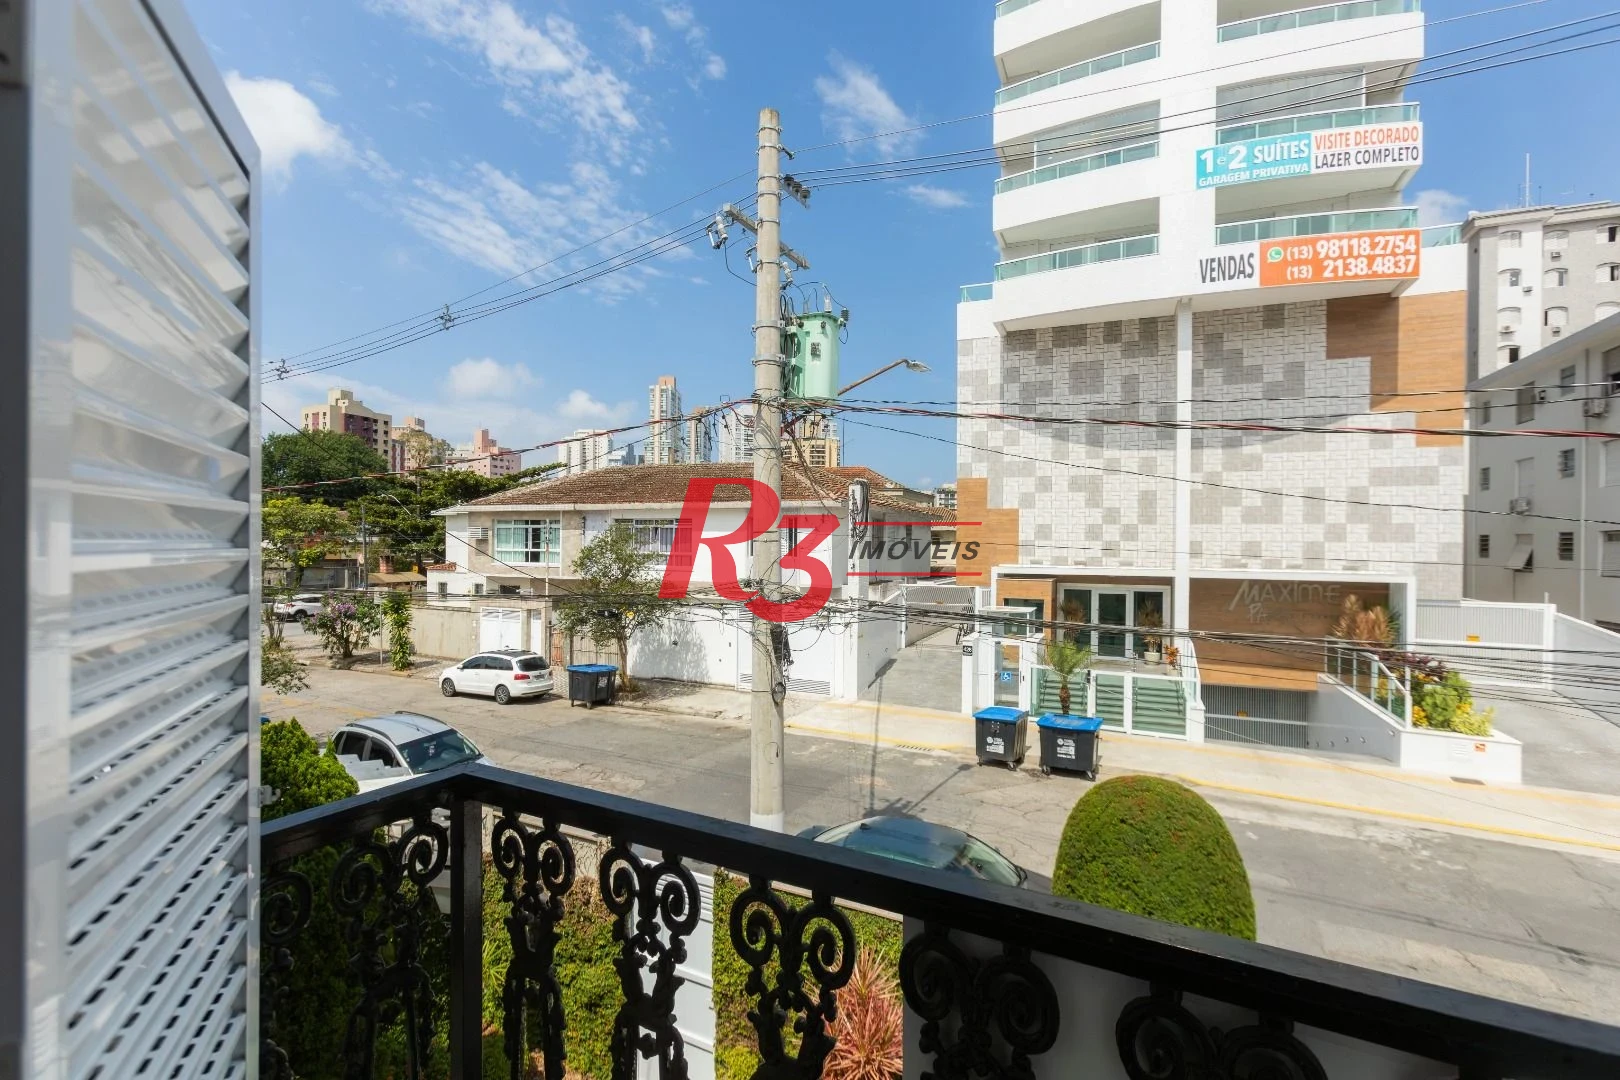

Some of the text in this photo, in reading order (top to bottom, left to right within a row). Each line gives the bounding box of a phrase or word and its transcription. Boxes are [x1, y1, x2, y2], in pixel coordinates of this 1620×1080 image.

[1315, 126, 1419, 150] VISITE DECORADO
[1200, 149, 1214, 173] 1
[1228, 145, 1247, 170] 2
[1253, 139, 1309, 164] SUÍTES
[1315, 146, 1419, 169] LAZER COMPLETO
[1199, 163, 1309, 186] GARAGEM PRIVATIVA
[1286, 234, 1416, 261] (13) 98118.2754
[1200, 252, 1255, 284] VENDAS
[1287, 255, 1416, 280] (13) 2138.4837
